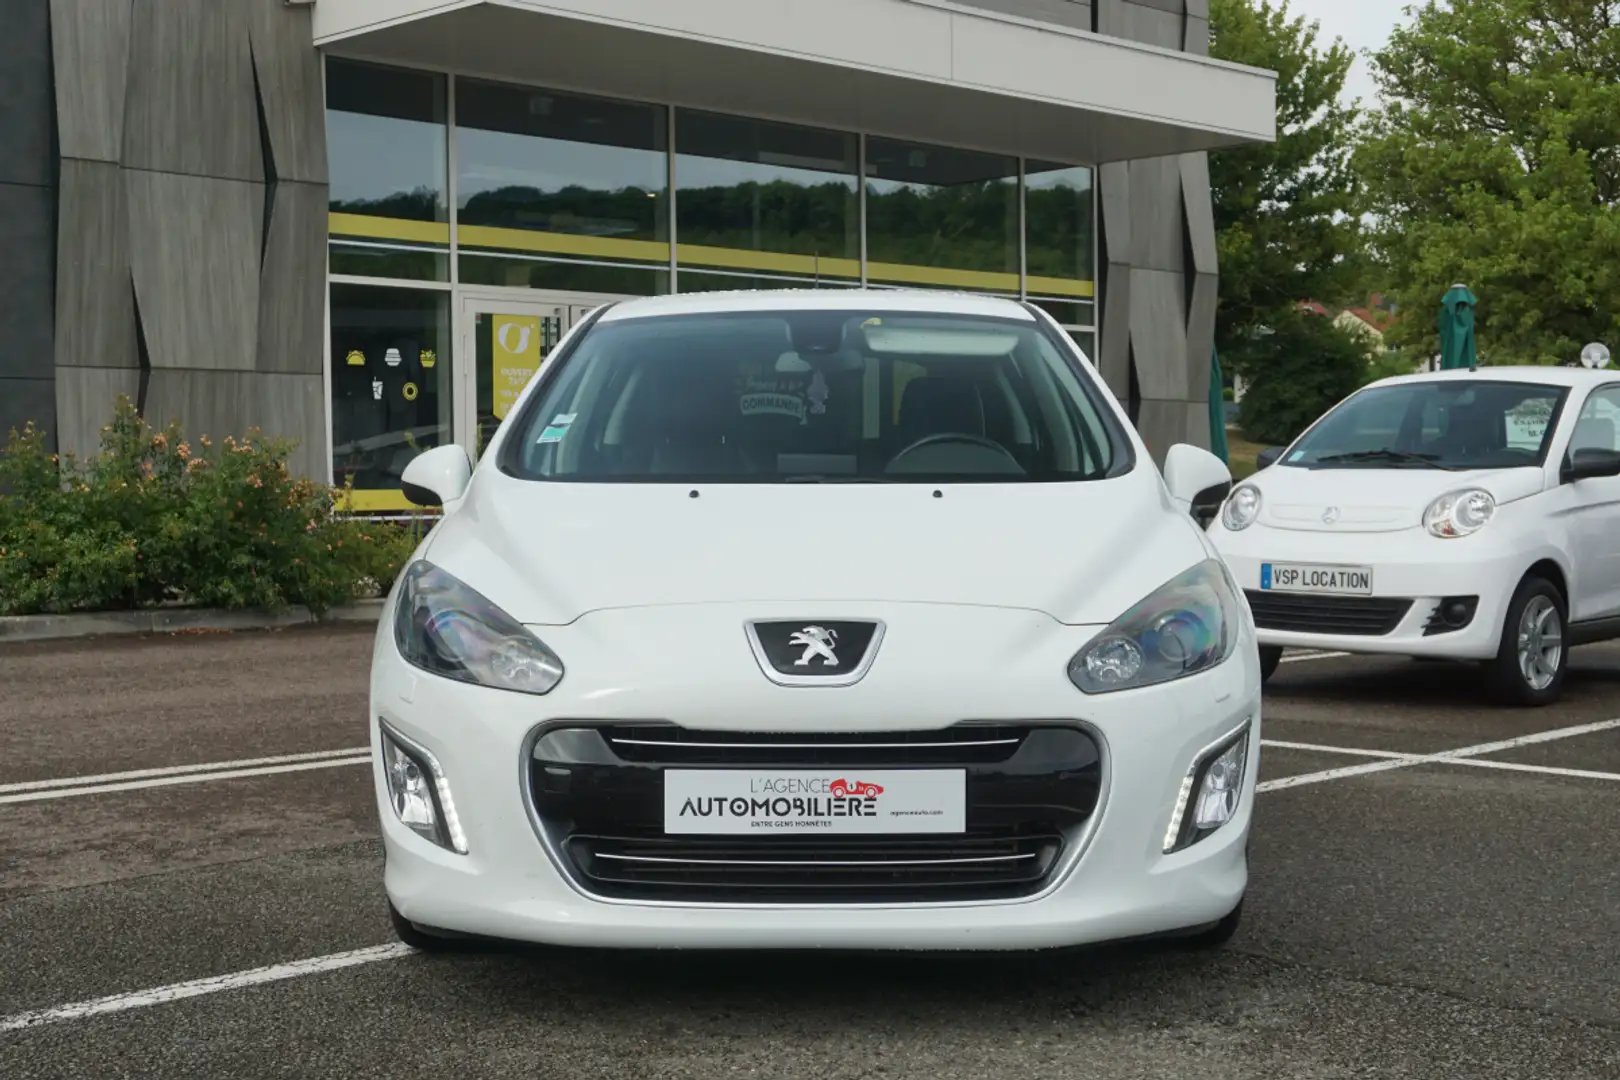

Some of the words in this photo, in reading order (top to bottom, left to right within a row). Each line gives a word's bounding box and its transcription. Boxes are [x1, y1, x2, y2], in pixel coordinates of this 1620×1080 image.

[742, 396, 801, 413] COMMANDE
[1274, 569, 1299, 585] VSP
[1302, 570, 1369, 589] LOCATION
[750, 778, 830, 794] L'AGENCE
[751, 820, 773, 828] ENTRE
[774, 820, 794, 828] GENS
